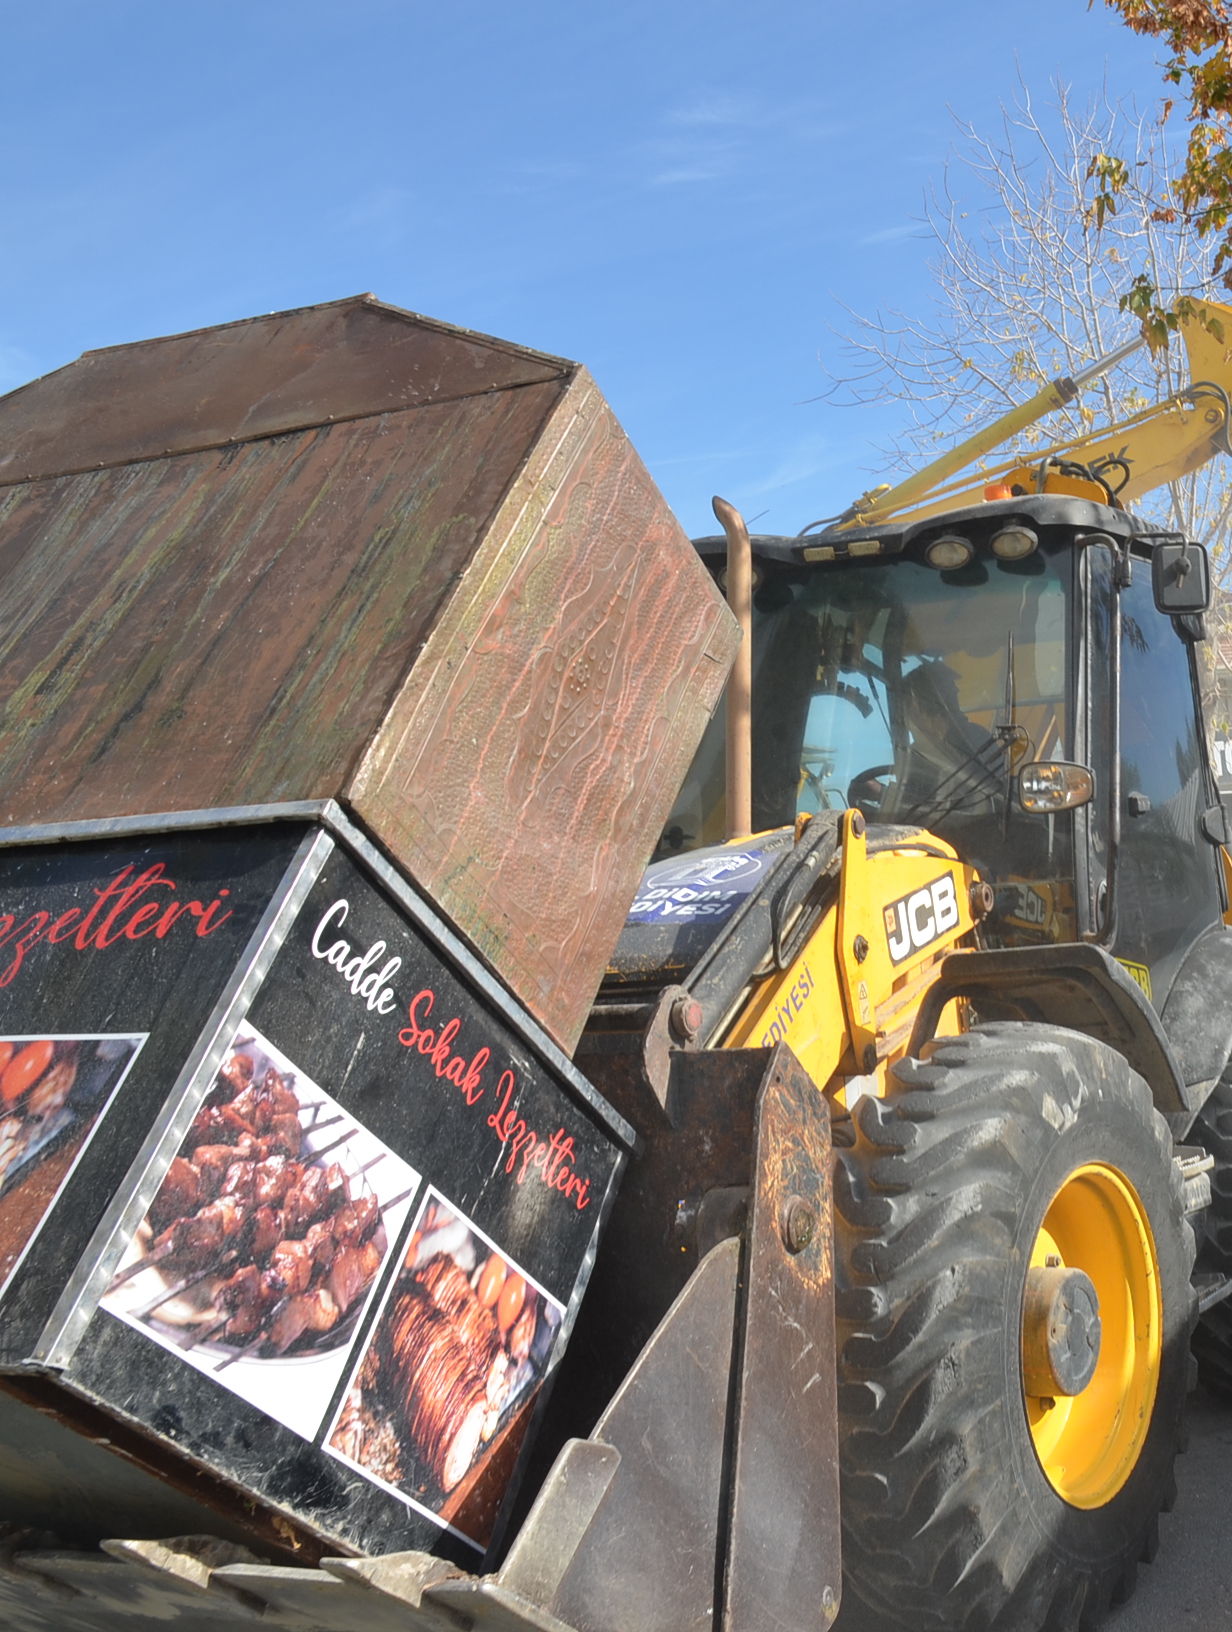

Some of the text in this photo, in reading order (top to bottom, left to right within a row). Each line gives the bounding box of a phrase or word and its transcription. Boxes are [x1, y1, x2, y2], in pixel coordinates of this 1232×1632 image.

[888, 876, 958, 961] JCB
[312, 899, 590, 1210] Cadde Sokak Lezzetleri
